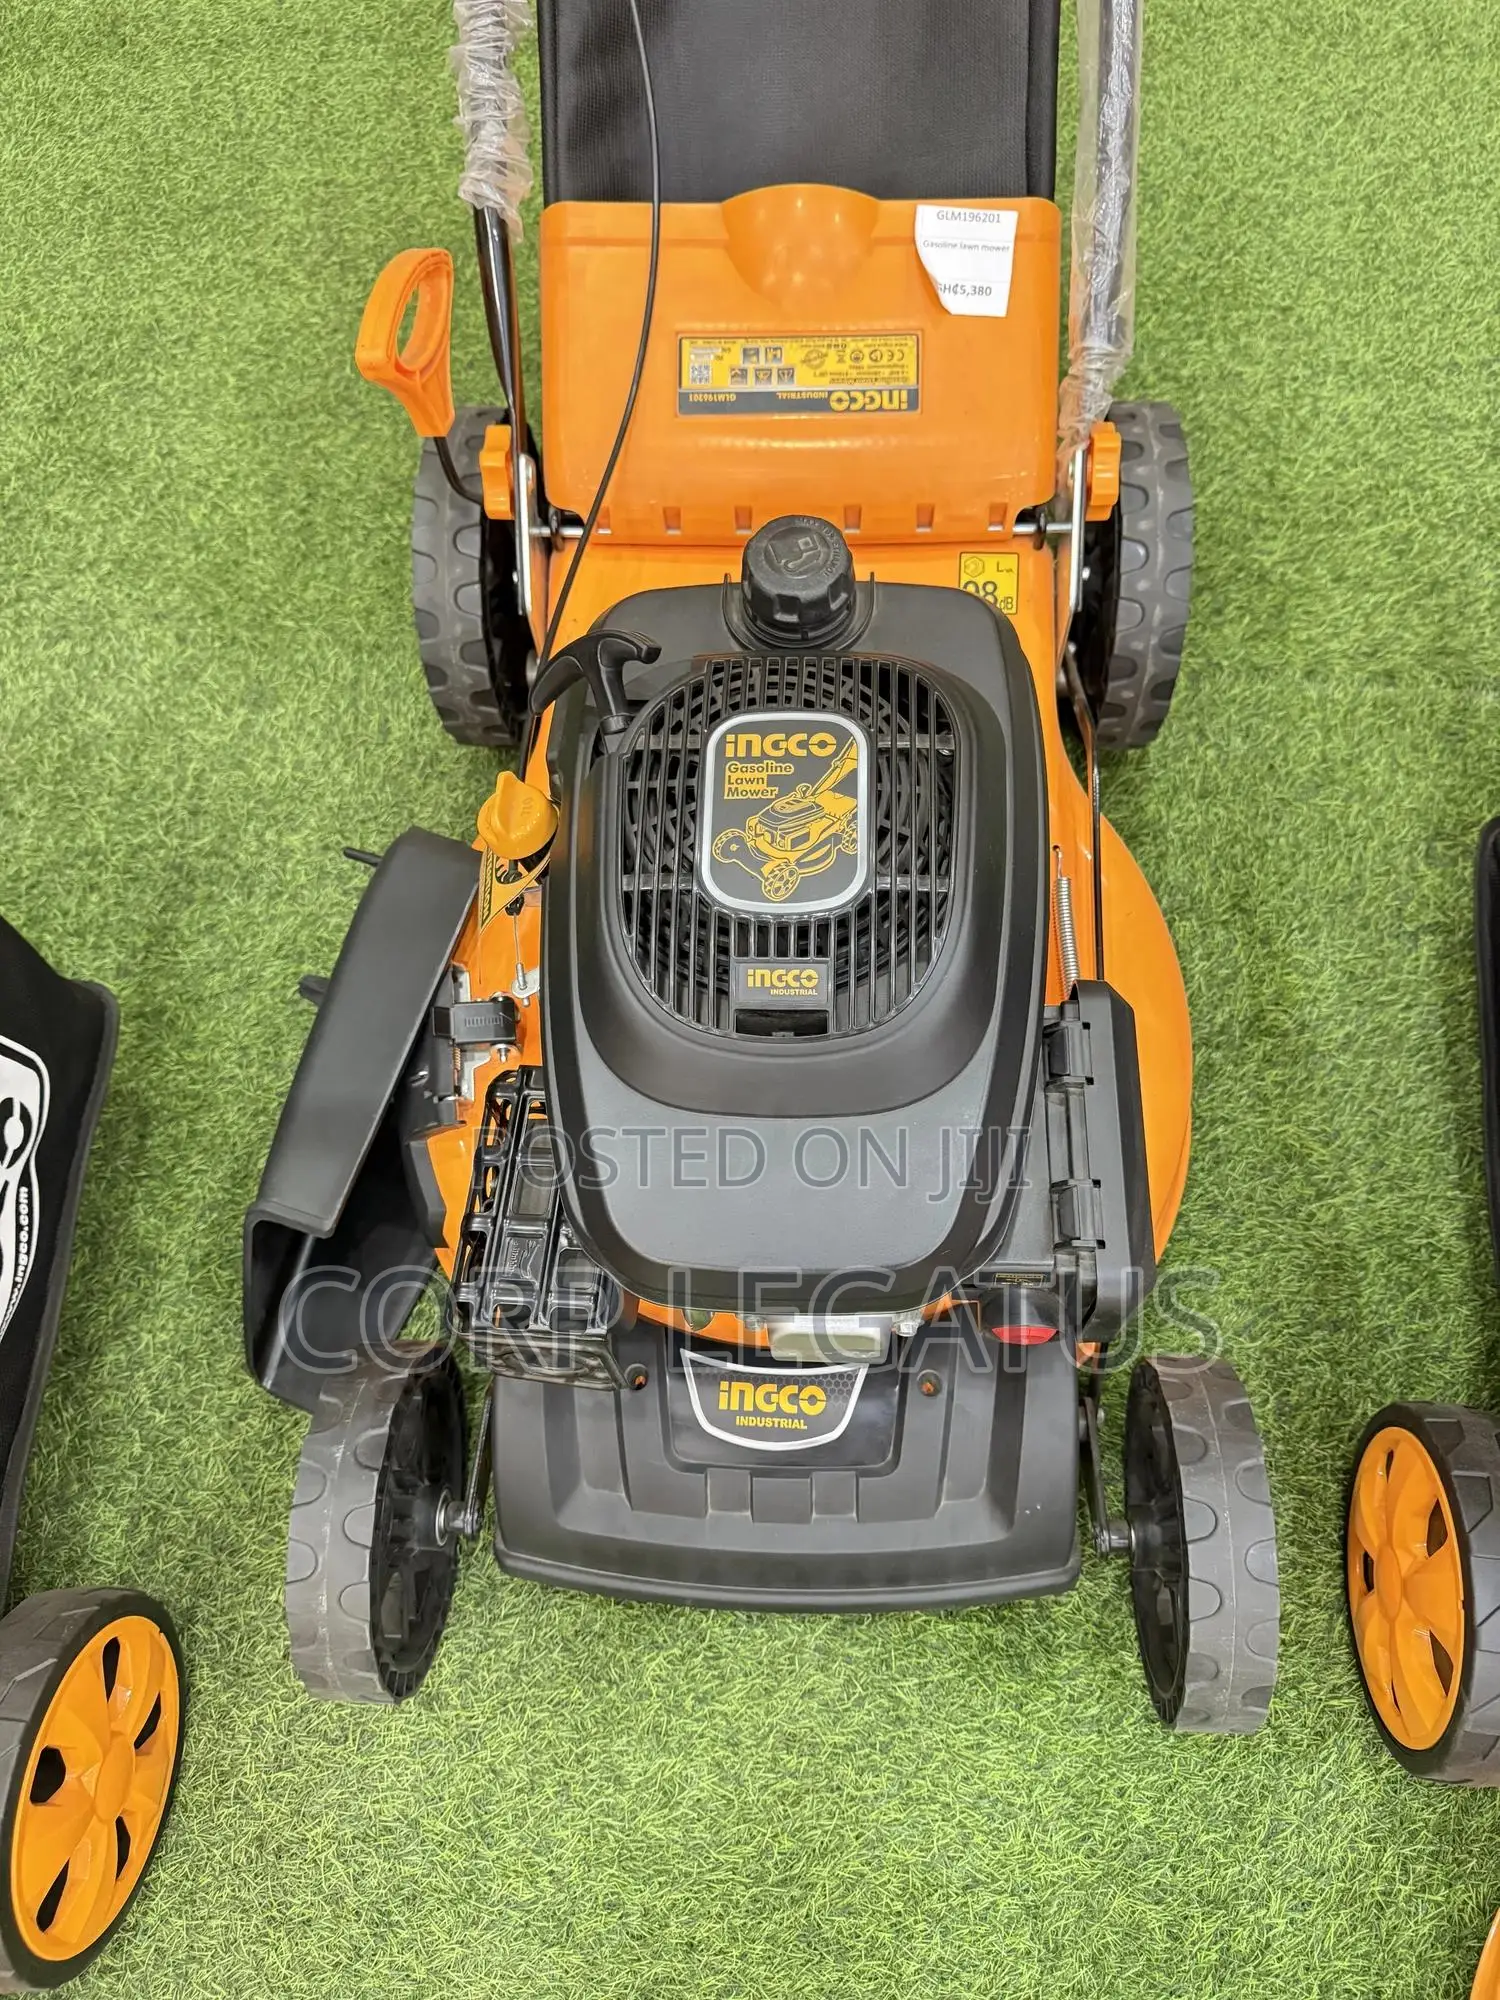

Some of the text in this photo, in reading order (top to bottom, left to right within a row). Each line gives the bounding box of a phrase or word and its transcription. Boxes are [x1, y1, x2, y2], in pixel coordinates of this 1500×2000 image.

[937, 210, 1001, 223] GLM196201
[923, 240, 1010, 253] Gasoline lawn mower
[688, 393, 736, 402] GLM196201
[776, 391, 828, 399] INDUSTRIAL
[725, 733, 837, 758] INGCO
[728, 762, 793, 774] Gasoline
[728, 775, 765, 785] Lawn
[727, 787, 777, 798] Mower
[747, 968, 819, 988] INGCO
[718, 1380, 827, 1416] INGCO
[735, 1415, 808, 1430] INDUSTRIAL
